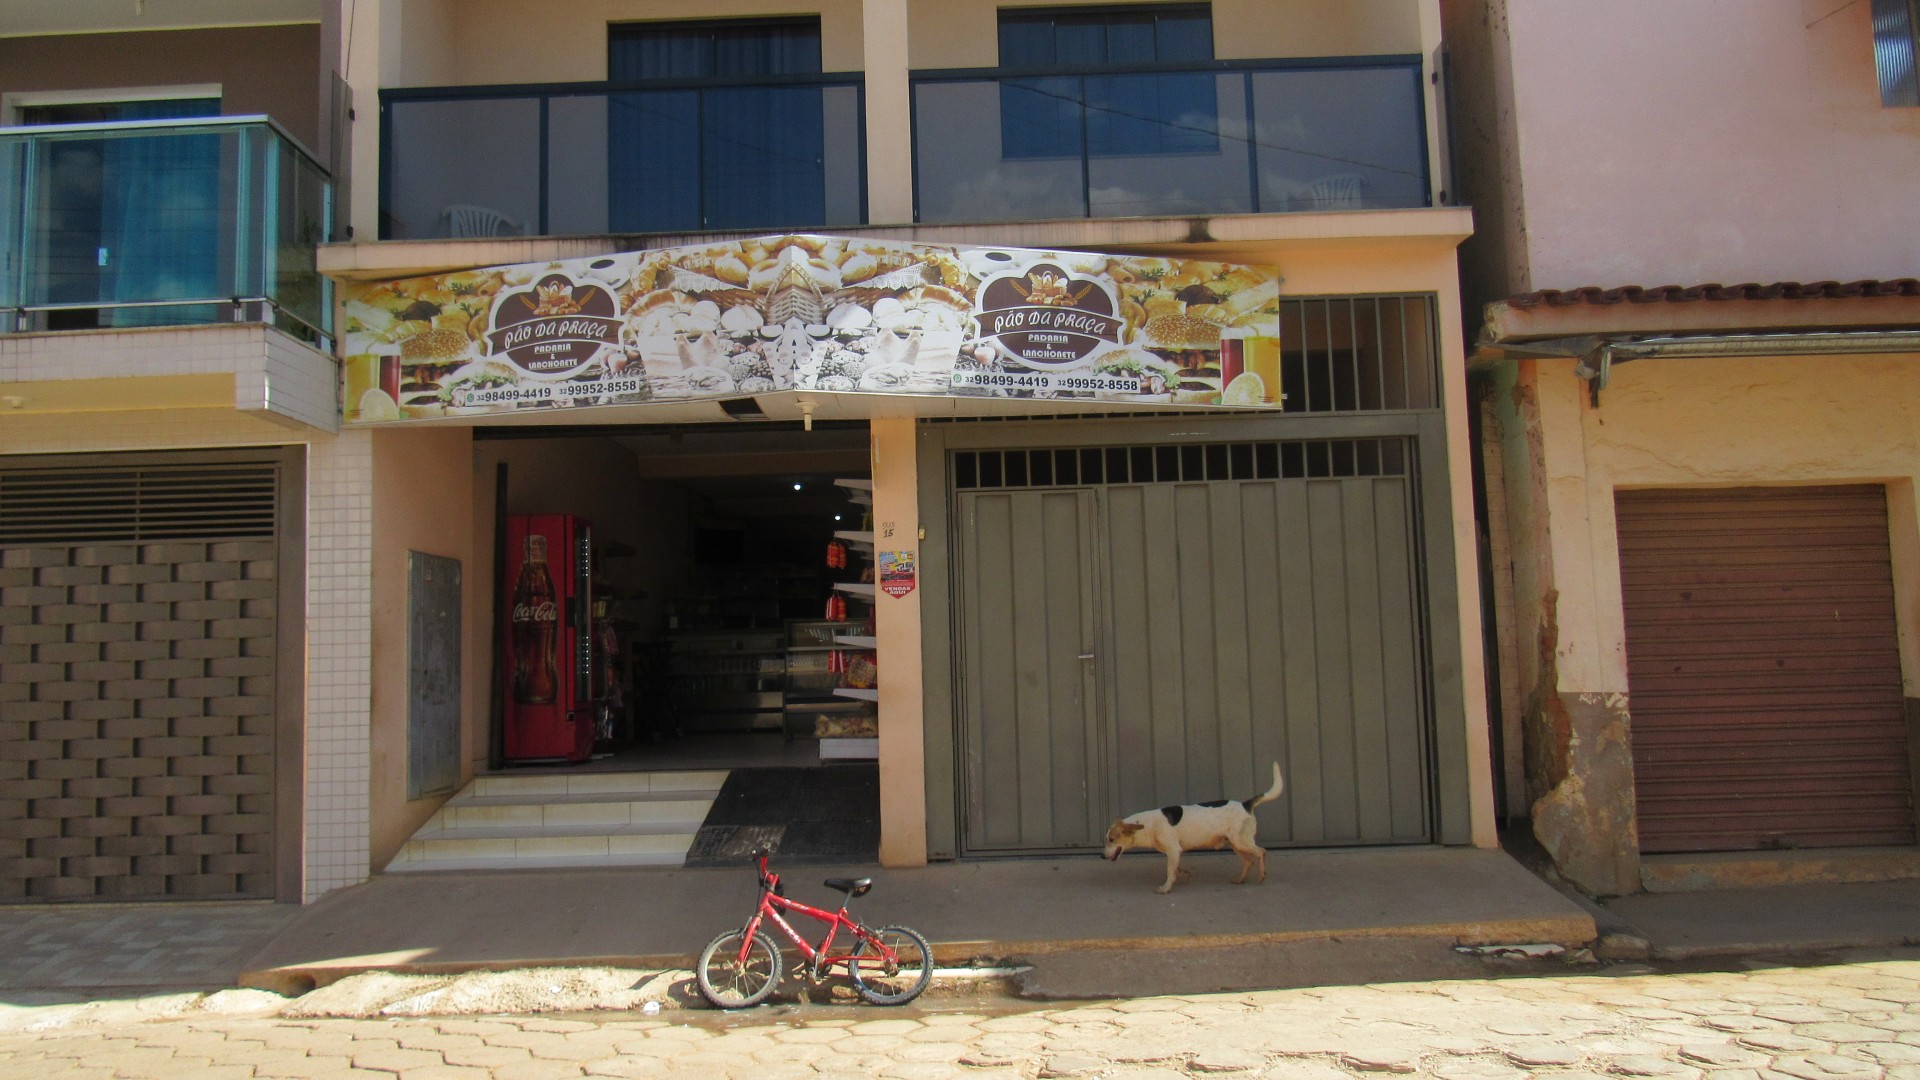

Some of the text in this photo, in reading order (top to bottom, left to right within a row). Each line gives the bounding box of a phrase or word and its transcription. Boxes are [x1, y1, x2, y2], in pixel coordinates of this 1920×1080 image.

[994, 310, 1107, 334] PÃO DA PRAÇA
[504, 320, 608, 349] PÃO DA PRAÇA
[1028, 334, 1069, 343] PADARIA
[534, 343, 572, 354] PADARIA
[1022, 349, 1077, 359] LANCHONETE
[528, 358, 578, 370] LANCHONETE
